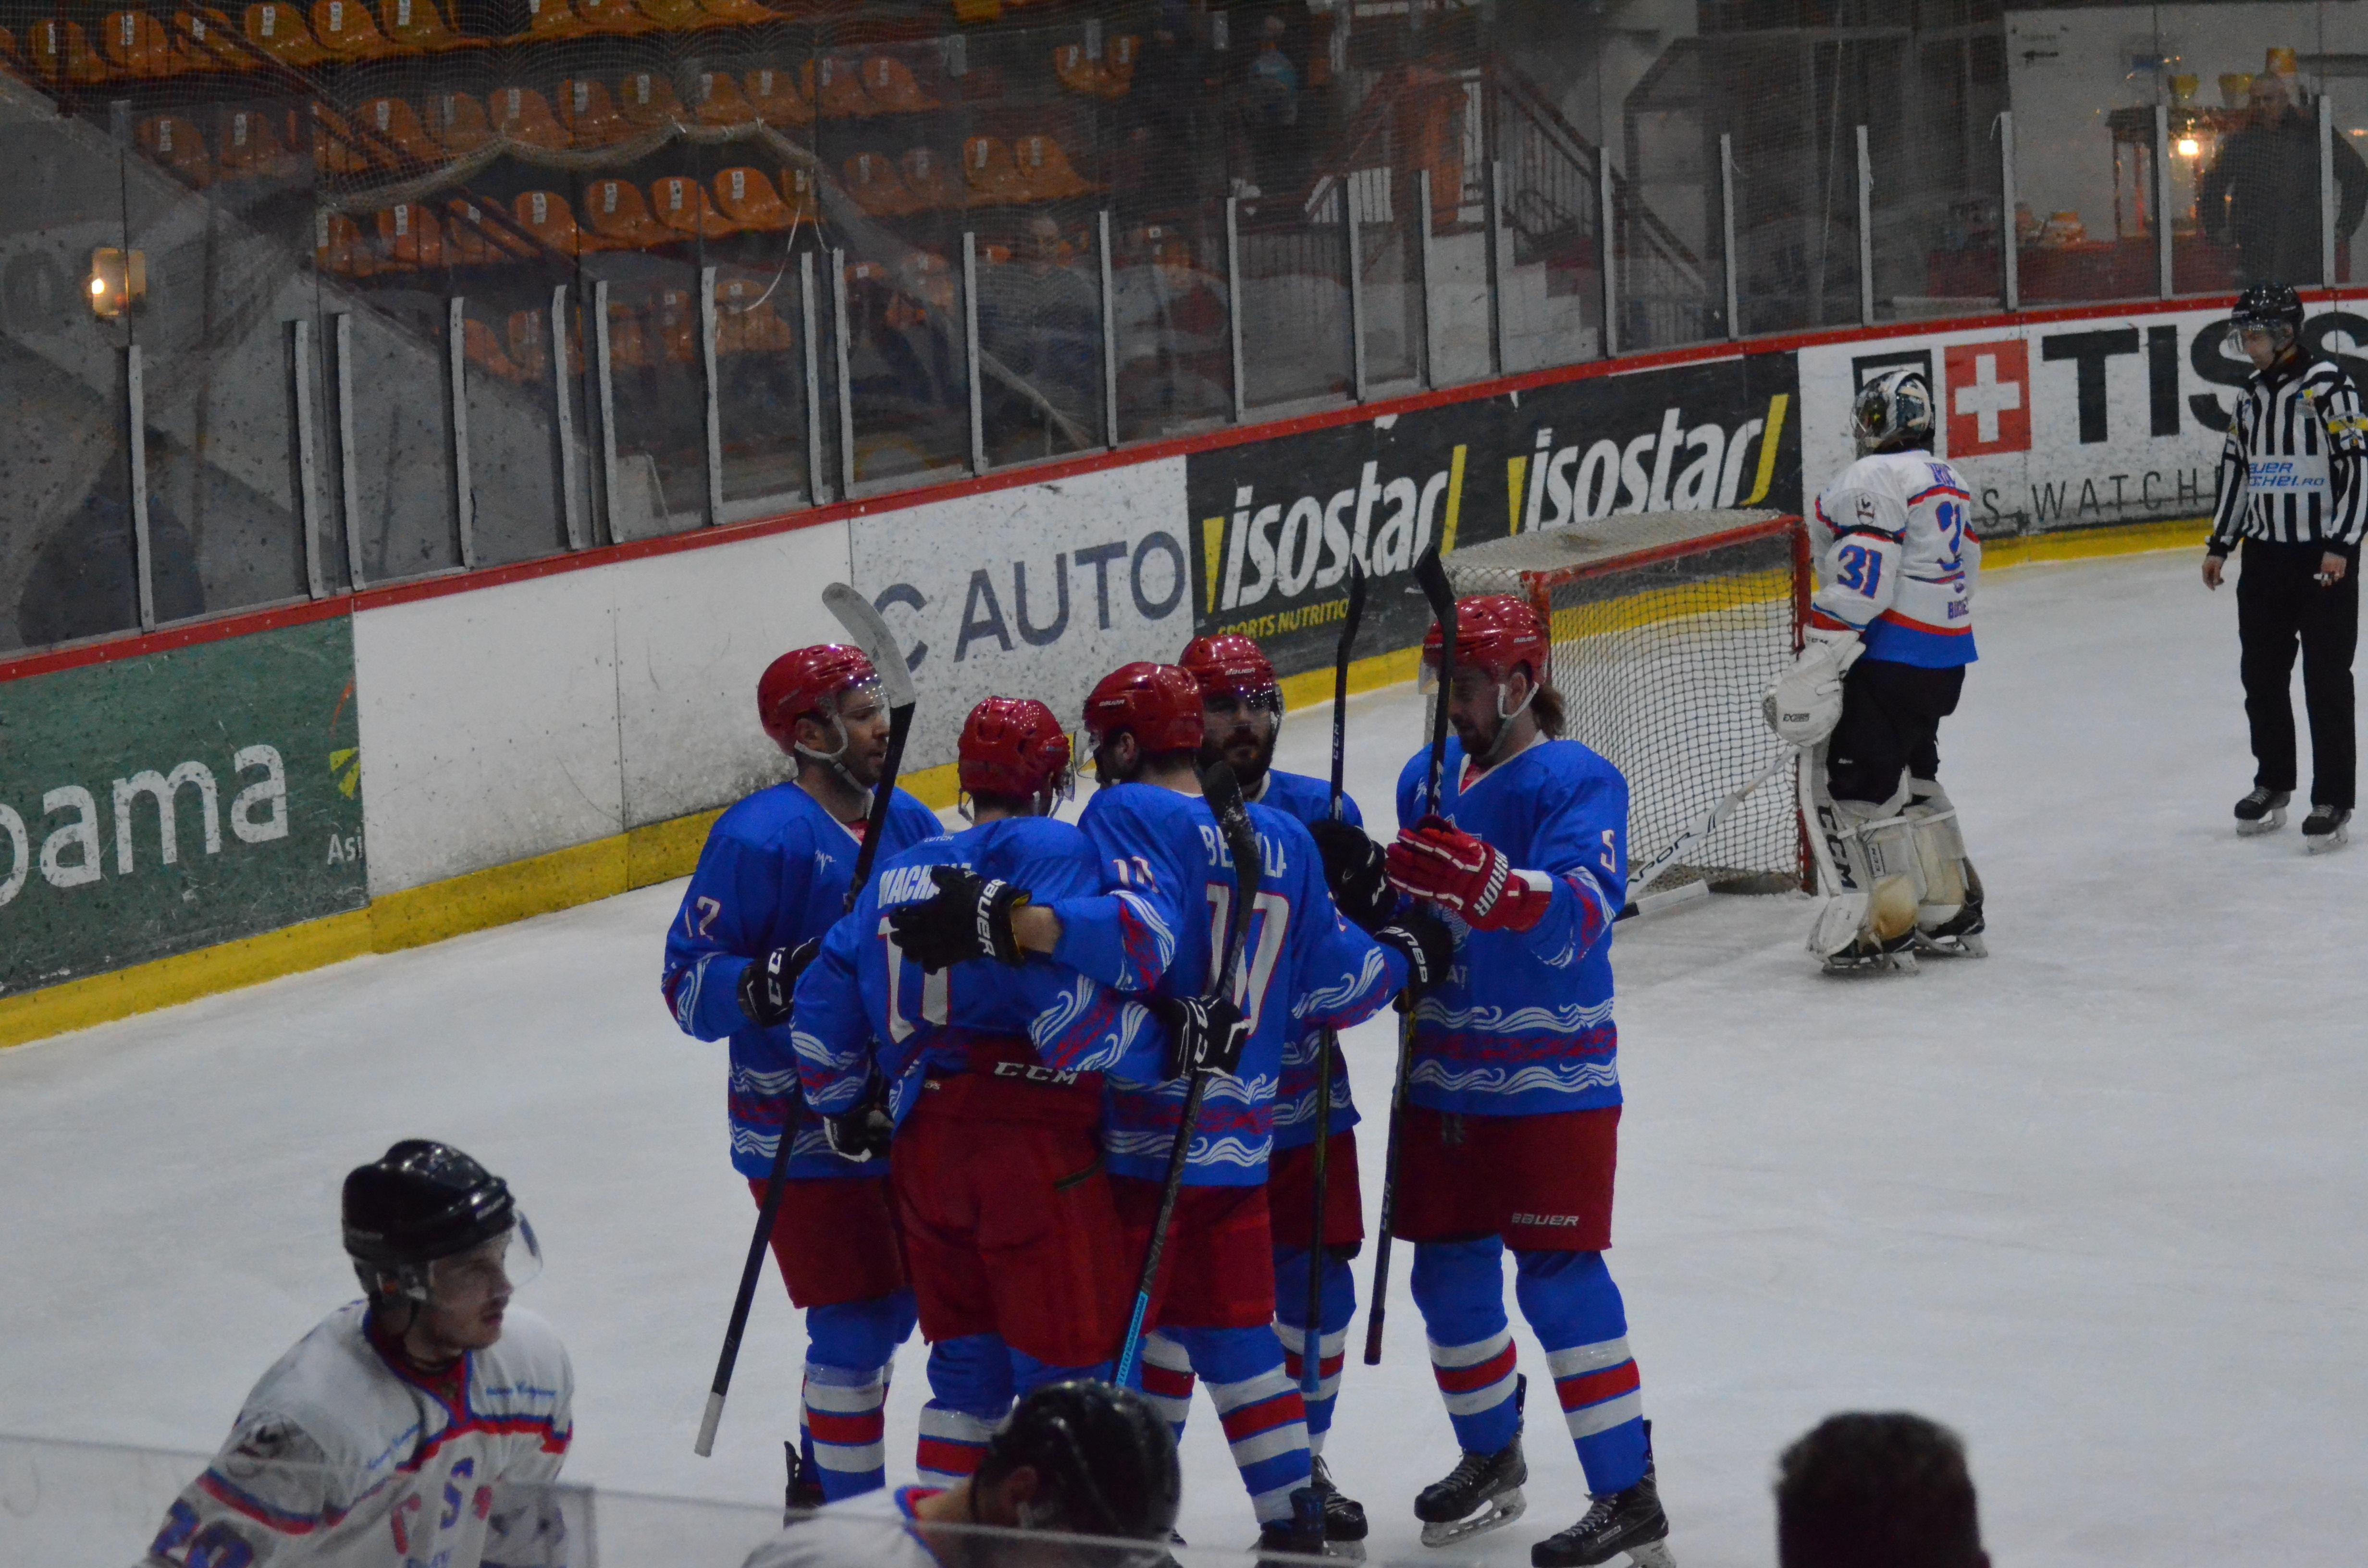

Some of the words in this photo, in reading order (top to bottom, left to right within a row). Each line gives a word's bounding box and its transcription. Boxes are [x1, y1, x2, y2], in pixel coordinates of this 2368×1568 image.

[1526, 407, 1764, 531] isostar
[1221, 460, 1450, 611] isostar
[953, 531, 1185, 663] AUTO
[1837, 544, 1883, 600] 31
[1278, 599, 1350, 634] NUTRITIO
[1600, 830, 1615, 873] 5
[1626, 832, 1702, 888] APOR
[1817, 805, 1858, 889] CCM
[684, 896, 721, 942] 12
[977, 878, 1007, 956] BAUER
[993, 1061, 1081, 1086] CCM
[1511, 1213, 1580, 1226] BAUER
